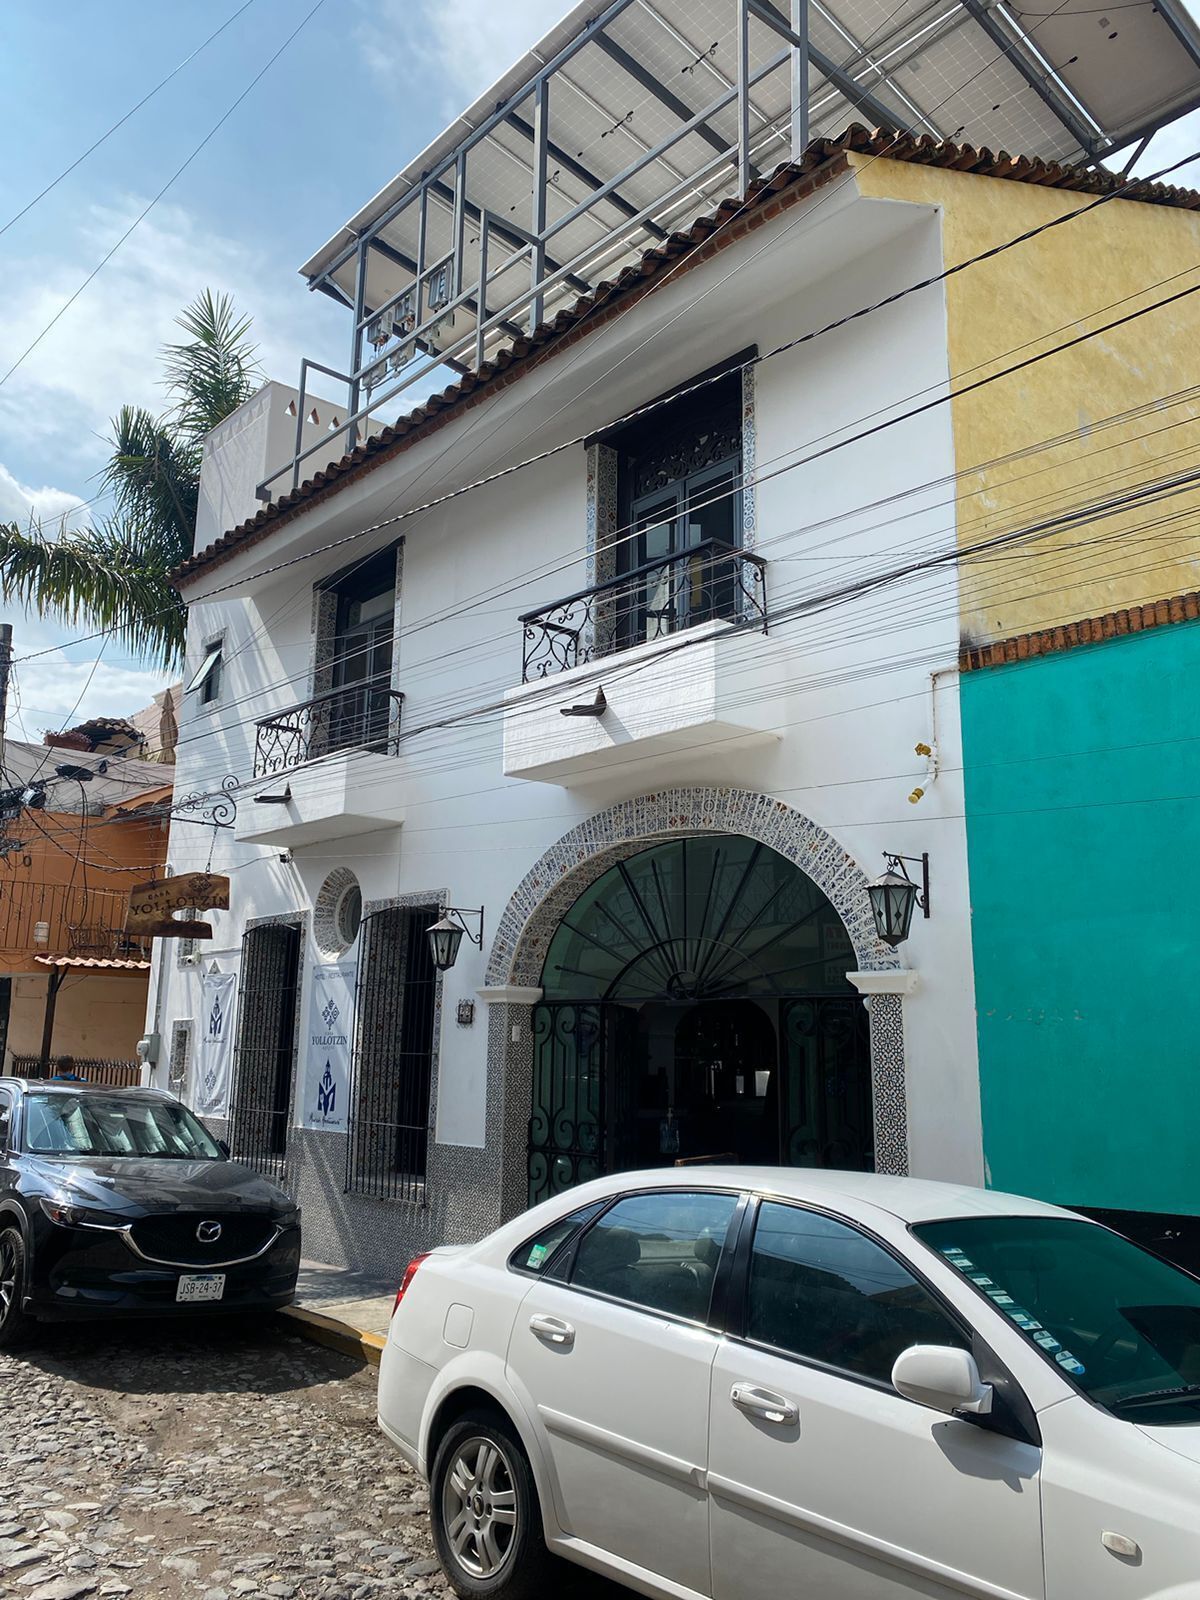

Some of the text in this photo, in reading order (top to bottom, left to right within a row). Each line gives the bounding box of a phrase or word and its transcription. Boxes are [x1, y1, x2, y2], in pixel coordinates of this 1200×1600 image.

[129, 895, 228, 916] YOLLOTZIN
[312, 1035, 348, 1046] YOLLOTZIN
[180, 1282, 223, 1295] JSB-24-37
